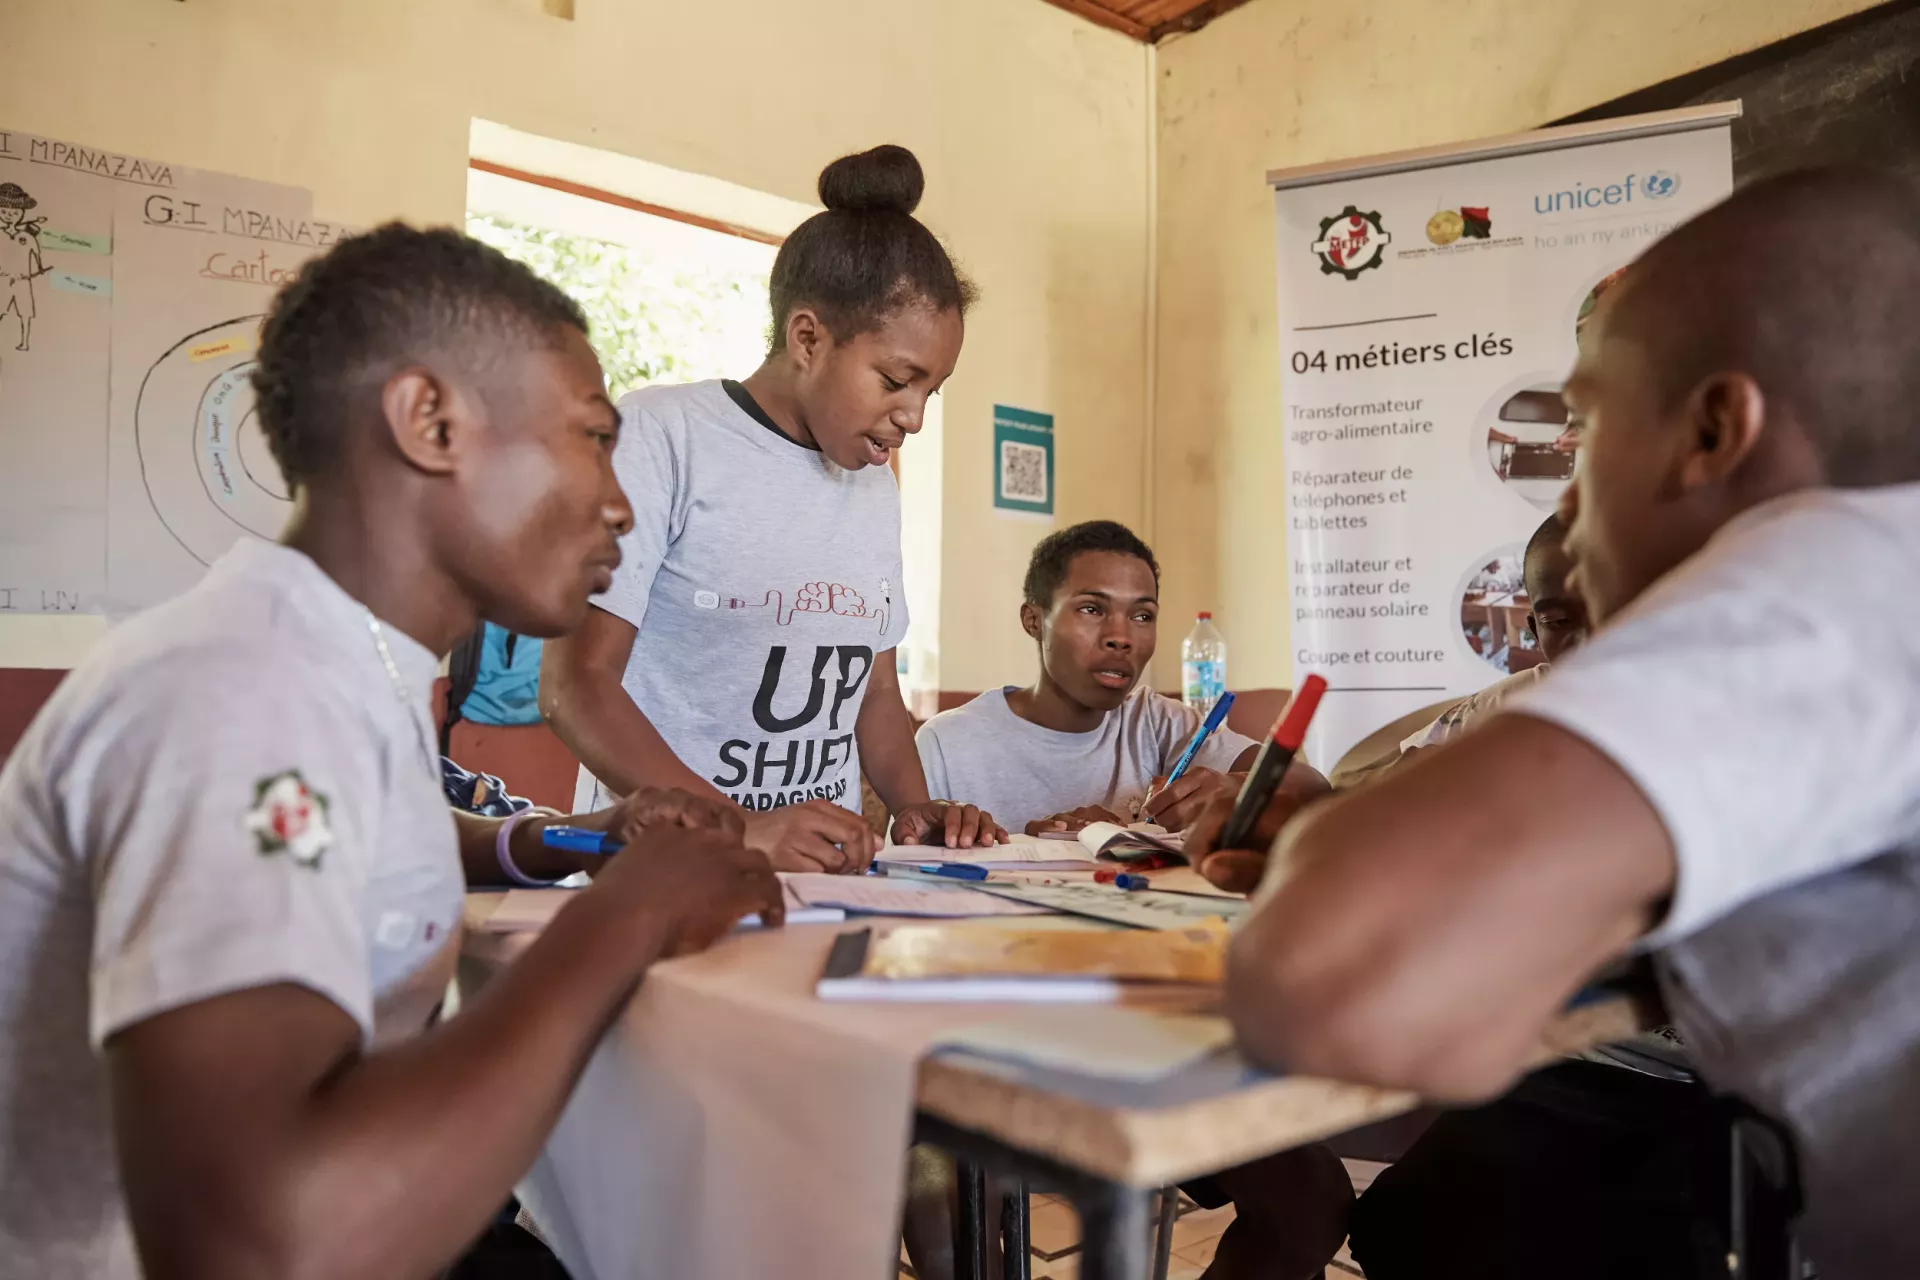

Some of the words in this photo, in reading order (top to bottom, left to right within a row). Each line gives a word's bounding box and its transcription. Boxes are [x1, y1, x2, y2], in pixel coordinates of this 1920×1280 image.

[31, 138, 173, 185] MPANAZAVA
[1534, 174, 1636, 214] unicef
[222, 206, 352, 246] MPANAZ
[1534, 236, 1558, 249] ho
[1563, 233, 1586, 246] an
[1291, 349, 1328, 374] 04
[1335, 340, 1446, 372] métiers
[1454, 332, 1514, 360] clés
[1291, 397, 1423, 420] Transformateur
[1290, 418, 1434, 445] agro-alimentaire
[1292, 468, 1387, 488] Réparateur
[1390, 465, 1414, 481] de
[1388, 488, 1408, 503] et
[1394, 556, 1412, 571] et
[1388, 578, 1411, 594] de
[1369, 601, 1429, 618] solaire
[1297, 648, 1351, 666] Coupe
[1353, 648, 1371, 663] et
[1374, 648, 1445, 664] couture
[752, 645, 873, 733] UP
